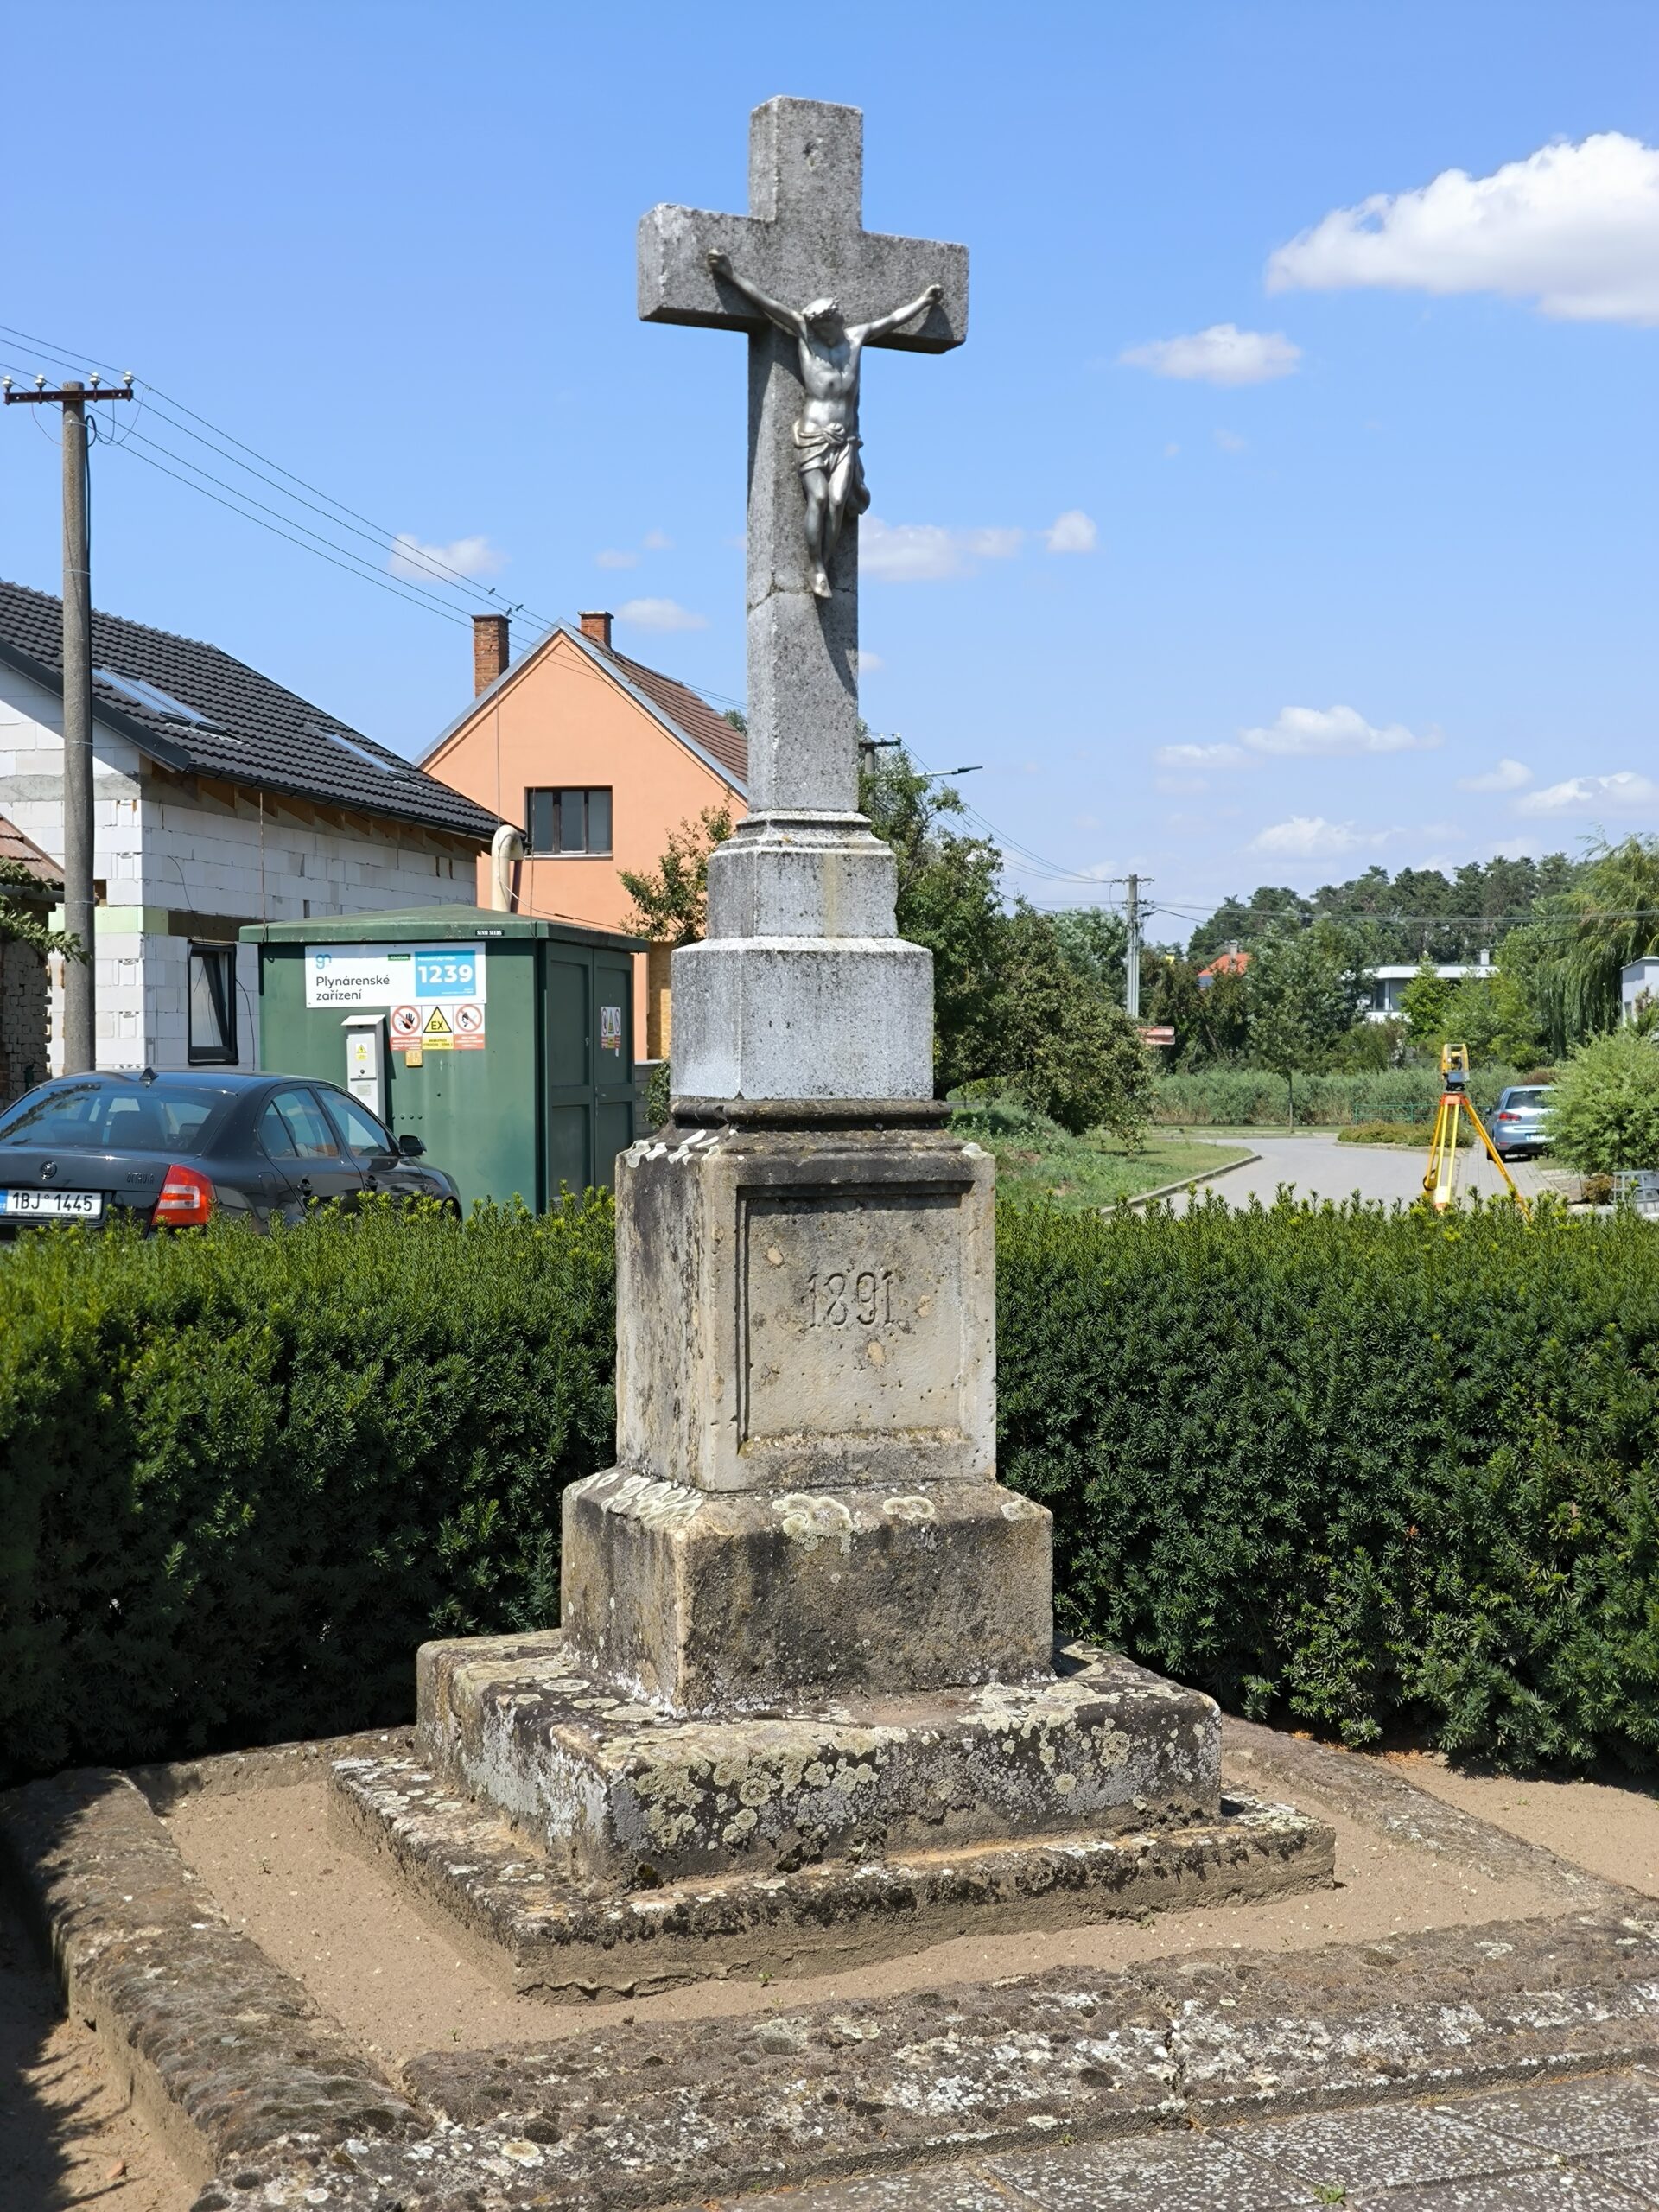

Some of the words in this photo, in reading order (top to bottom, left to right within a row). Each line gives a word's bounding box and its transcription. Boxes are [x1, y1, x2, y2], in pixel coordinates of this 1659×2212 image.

[417, 964, 474, 983] 1239
[315, 974, 390, 989] Plynárenské
[316, 989, 362, 1001] zařízení
[431, 1021, 444, 1030] EX
[126, 1172, 155, 1185] OCTAVIA
[12, 1192, 41, 1210] 1BJ
[54, 1194, 93, 1211] 1445
[807, 1271, 893, 1328] 1891
